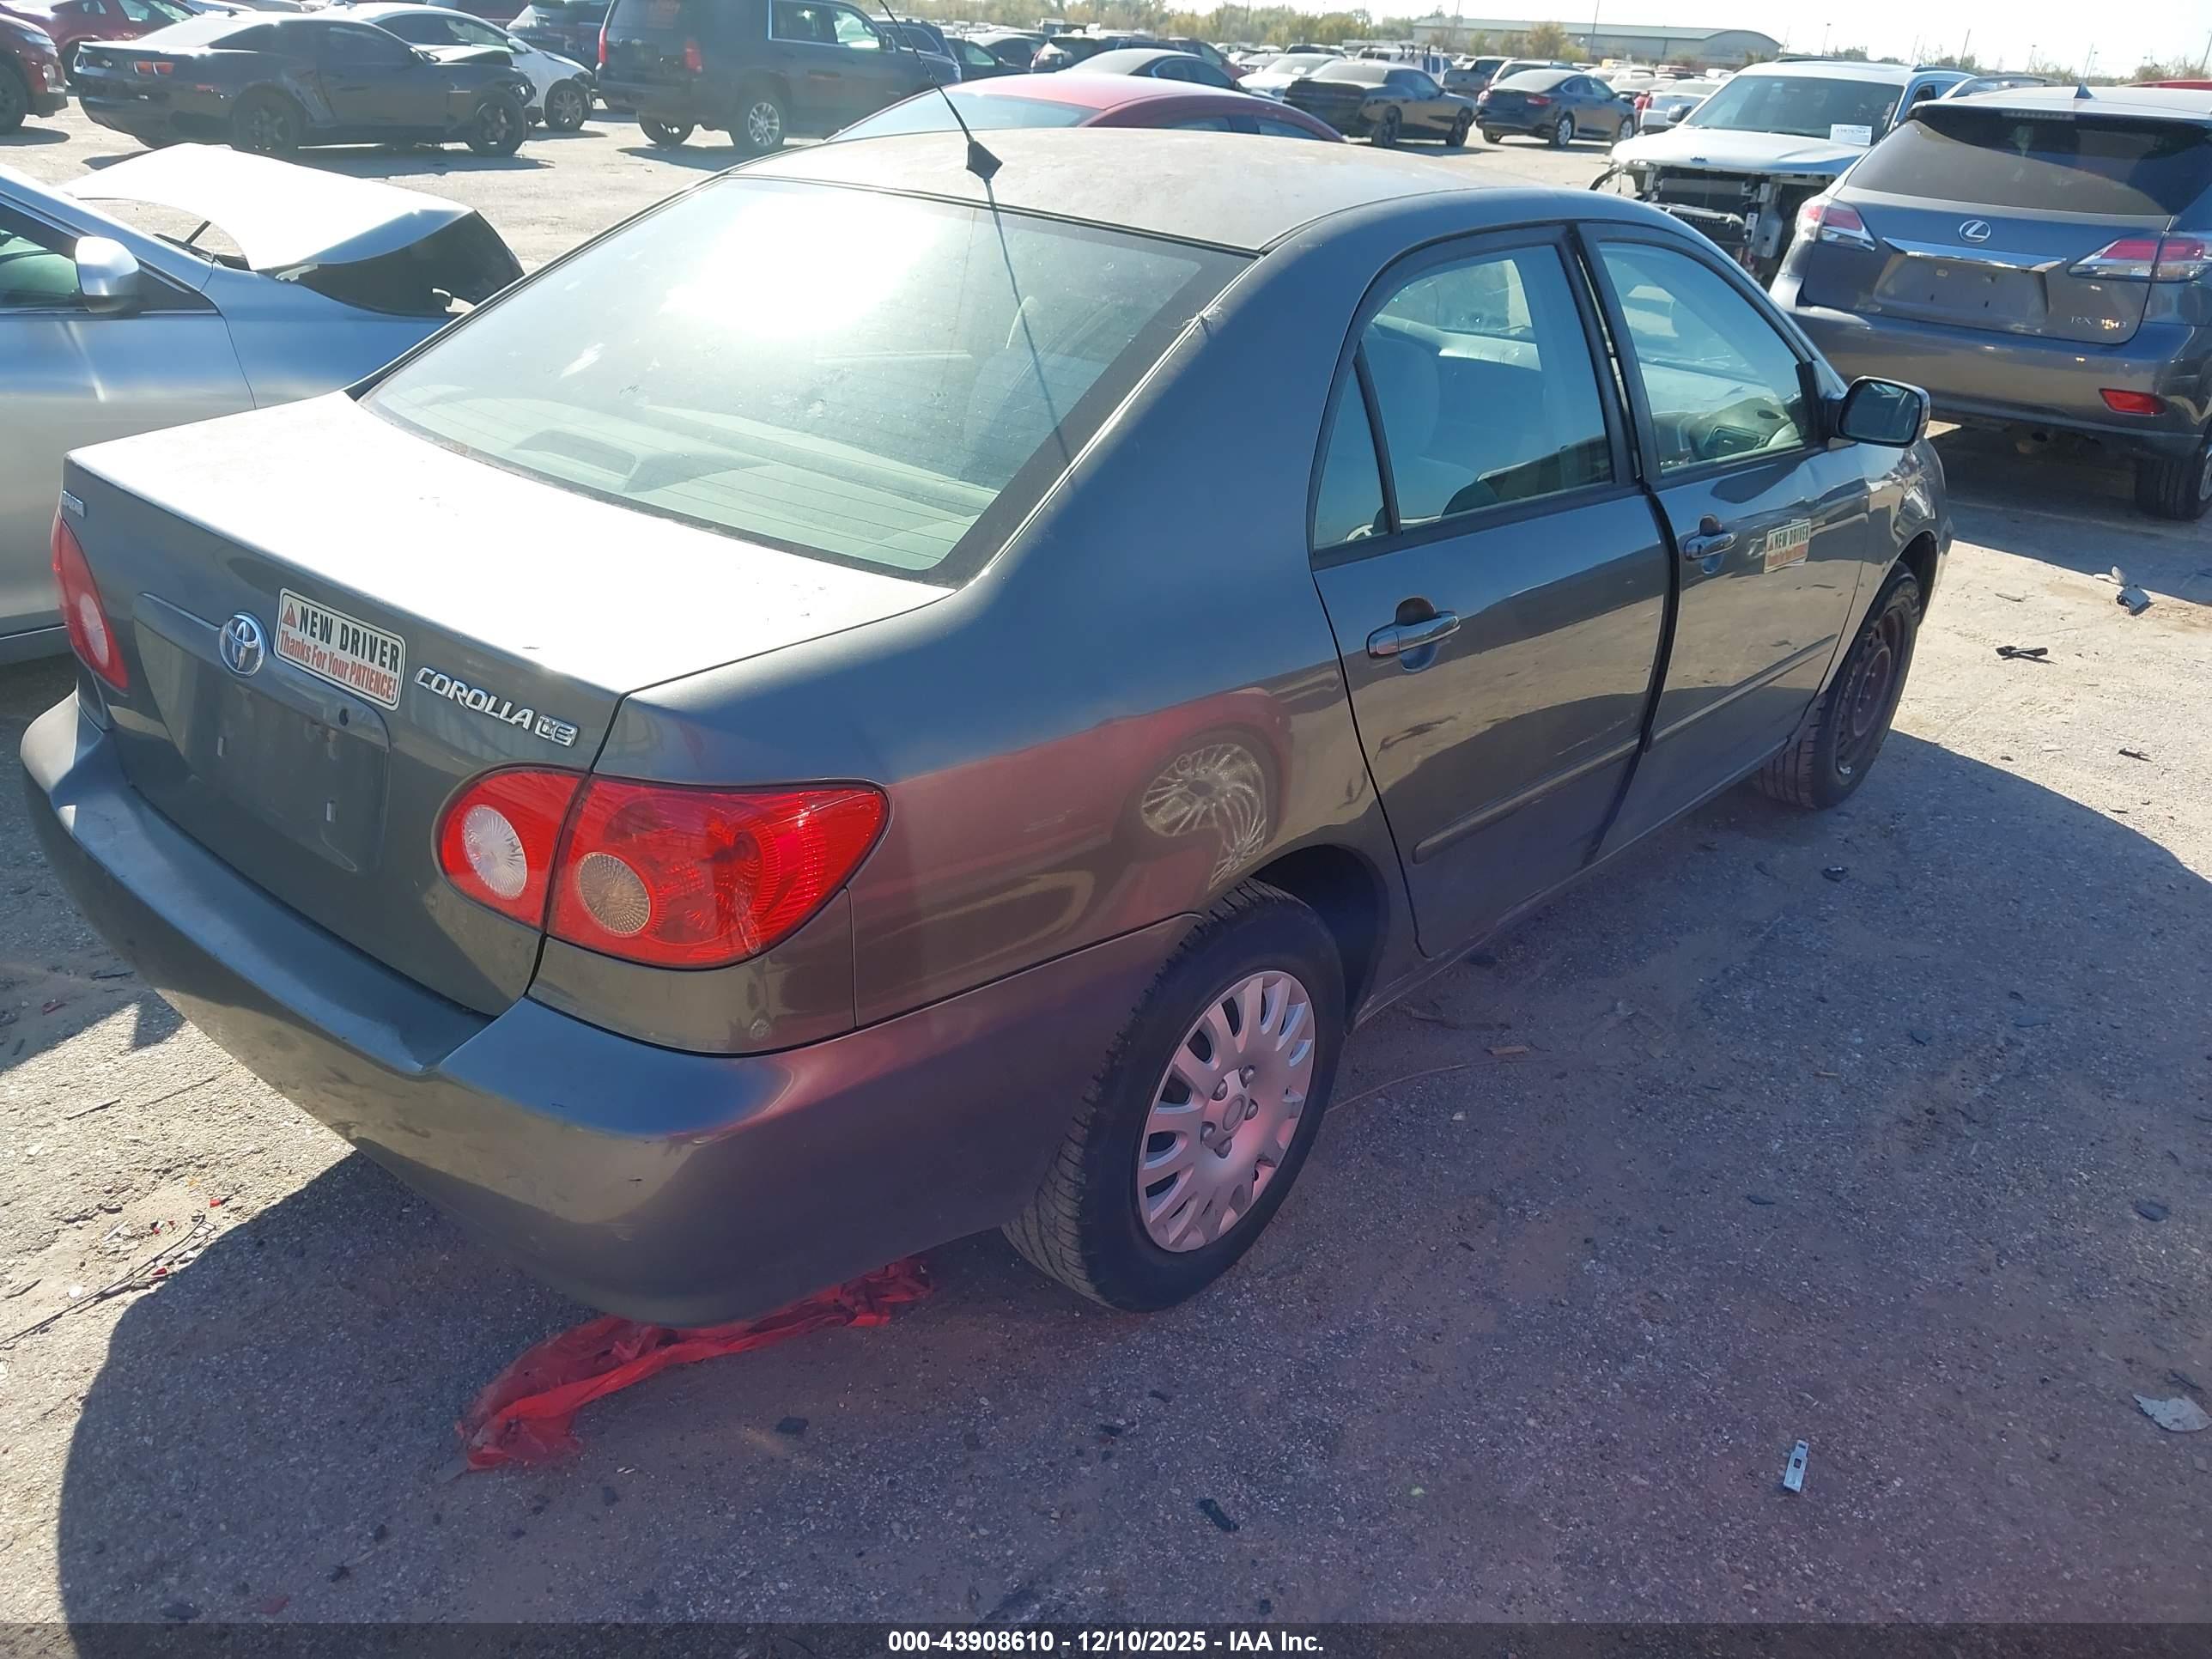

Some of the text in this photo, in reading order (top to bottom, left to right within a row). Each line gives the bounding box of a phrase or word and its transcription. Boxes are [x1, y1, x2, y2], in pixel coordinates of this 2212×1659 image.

[1774, 525, 1809, 550] NEW DRIVER
[279, 629, 398, 702] Thanks For Your PATIENCE!
[298, 605, 400, 673] NEW DRIVER
[414, 666, 536, 730] COROLLA
